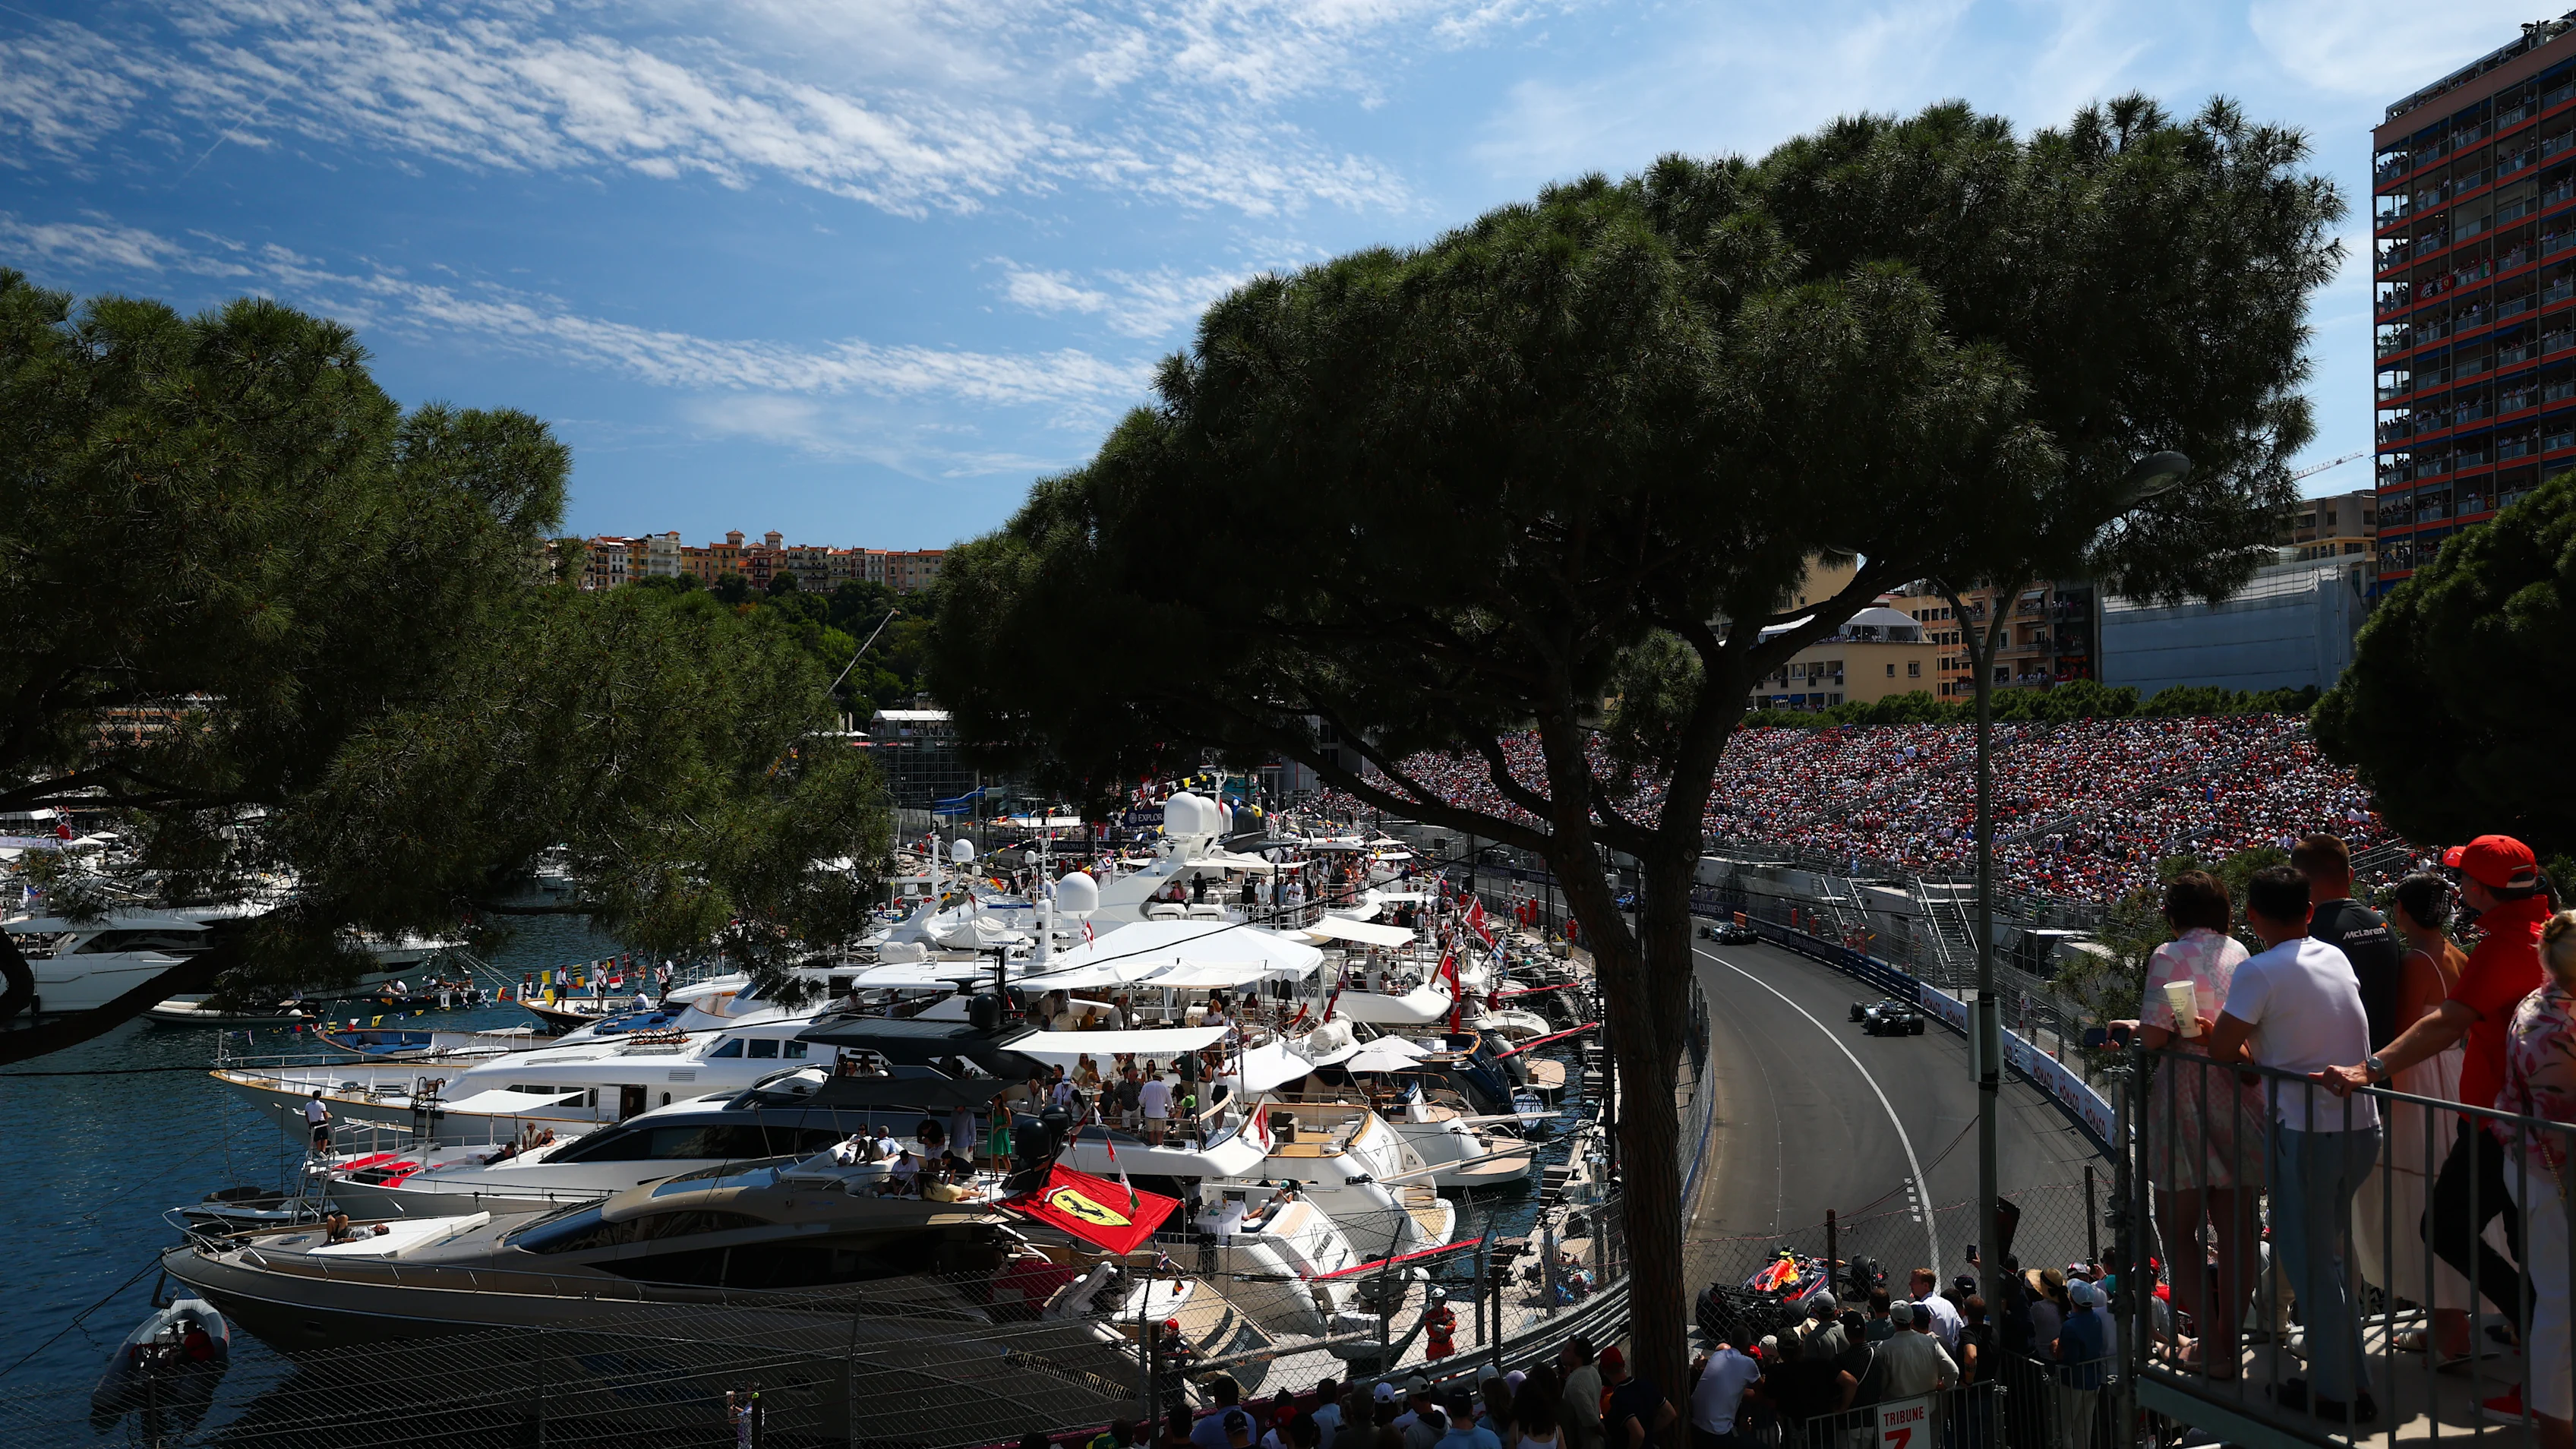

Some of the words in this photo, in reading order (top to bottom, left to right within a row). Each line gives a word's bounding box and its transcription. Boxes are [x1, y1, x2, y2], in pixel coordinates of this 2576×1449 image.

[1698, 903, 1724, 914] JOURNEYS
[2342, 927, 2386, 940] McLaren
[1792, 935, 1808, 949] EXPLORA
[1807, 940, 1826, 956] JOURNEYS
[1923, 996, 1941, 1015] MONACO
[1946, 1008, 1965, 1029] MONACO
[2033, 1064, 2054, 1090] MONACO
[2059, 1084, 2079, 1113] MONACO
[2085, 1106, 2106, 1138] MONACO
[1717, 1283, 1773, 1297] ORACLE
[1883, 1406, 1924, 1427] TRIBUNE
[1885, 1427, 1911, 1449] 7
